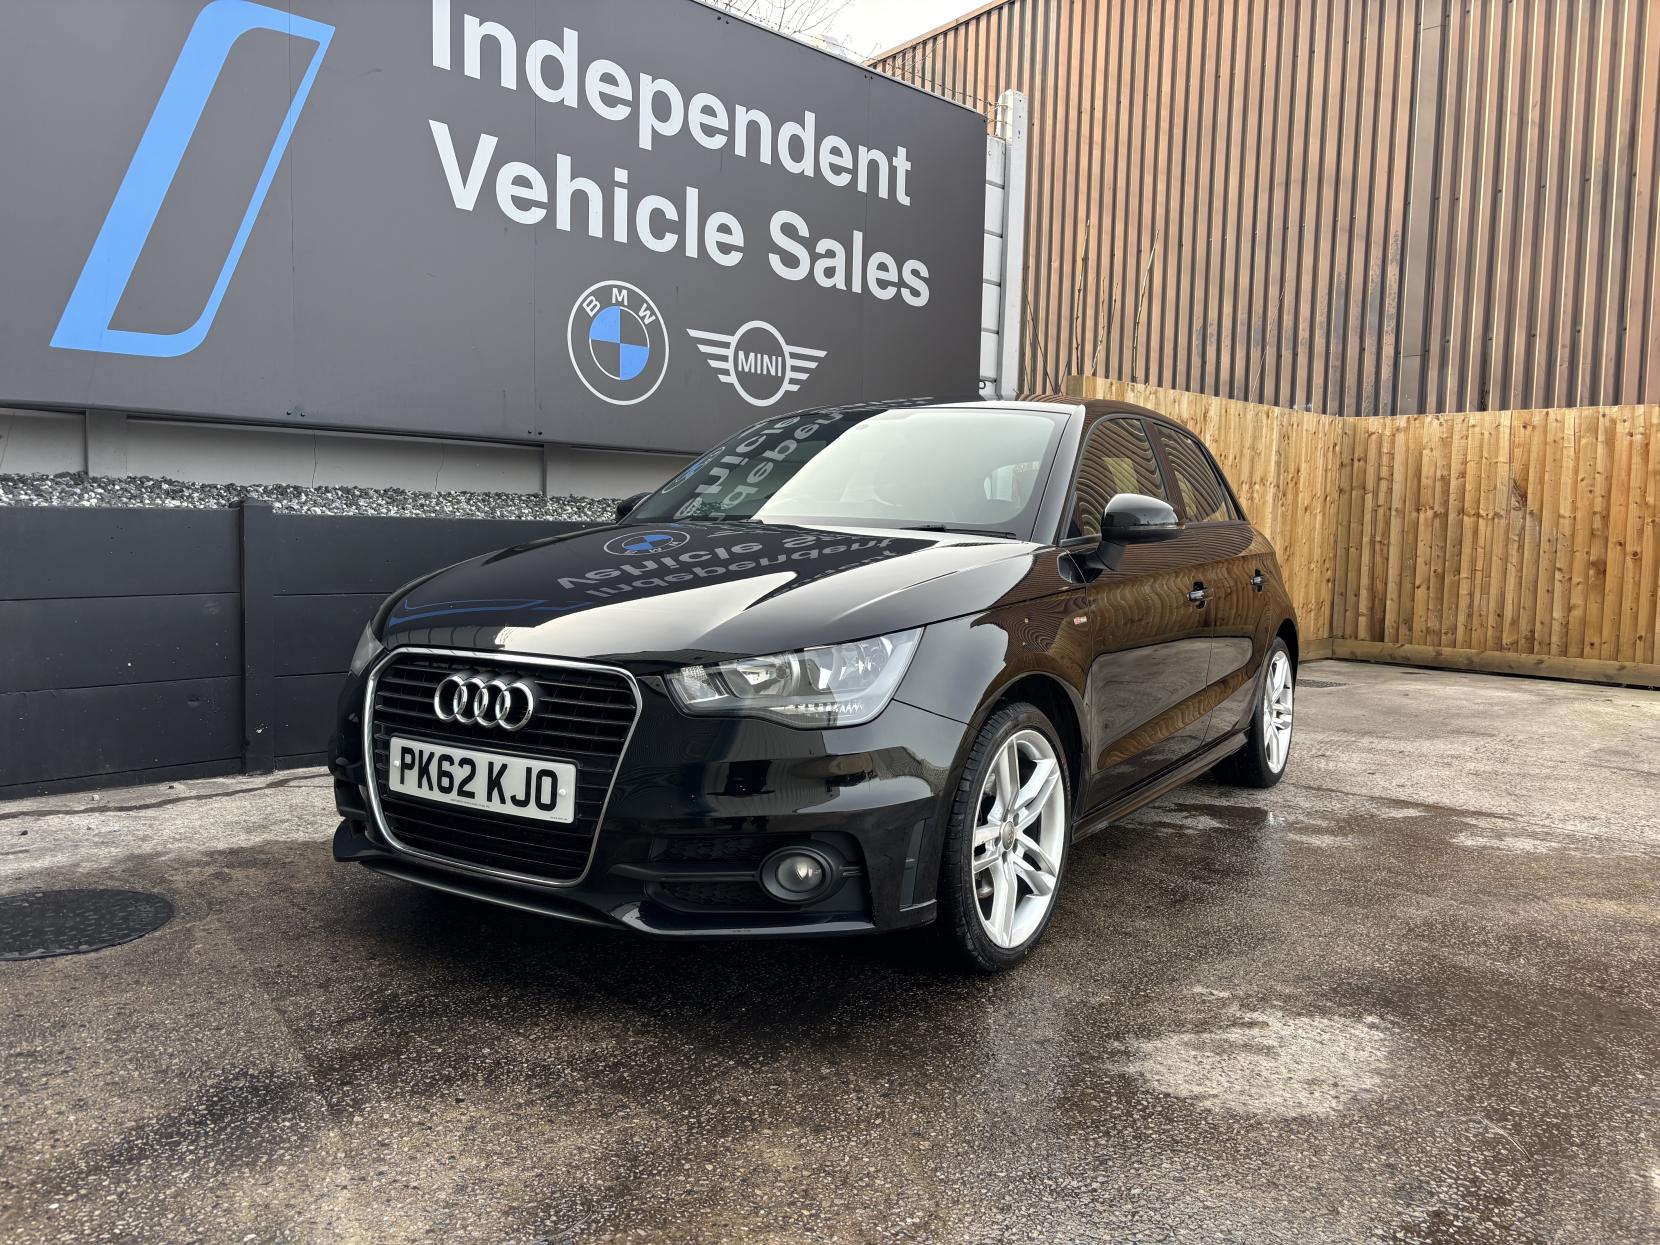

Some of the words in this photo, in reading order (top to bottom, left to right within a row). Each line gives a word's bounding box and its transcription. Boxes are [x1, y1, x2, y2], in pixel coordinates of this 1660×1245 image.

[432, 0, 911, 206] Independent
[428, 119, 744, 267] Vehicle
[768, 210, 930, 307] Sales
[583, 287, 656, 325] BMW
[738, 350, 782, 377] MINI
[399, 746, 477, 799] PK62
[486, 761, 559, 812] KJO
